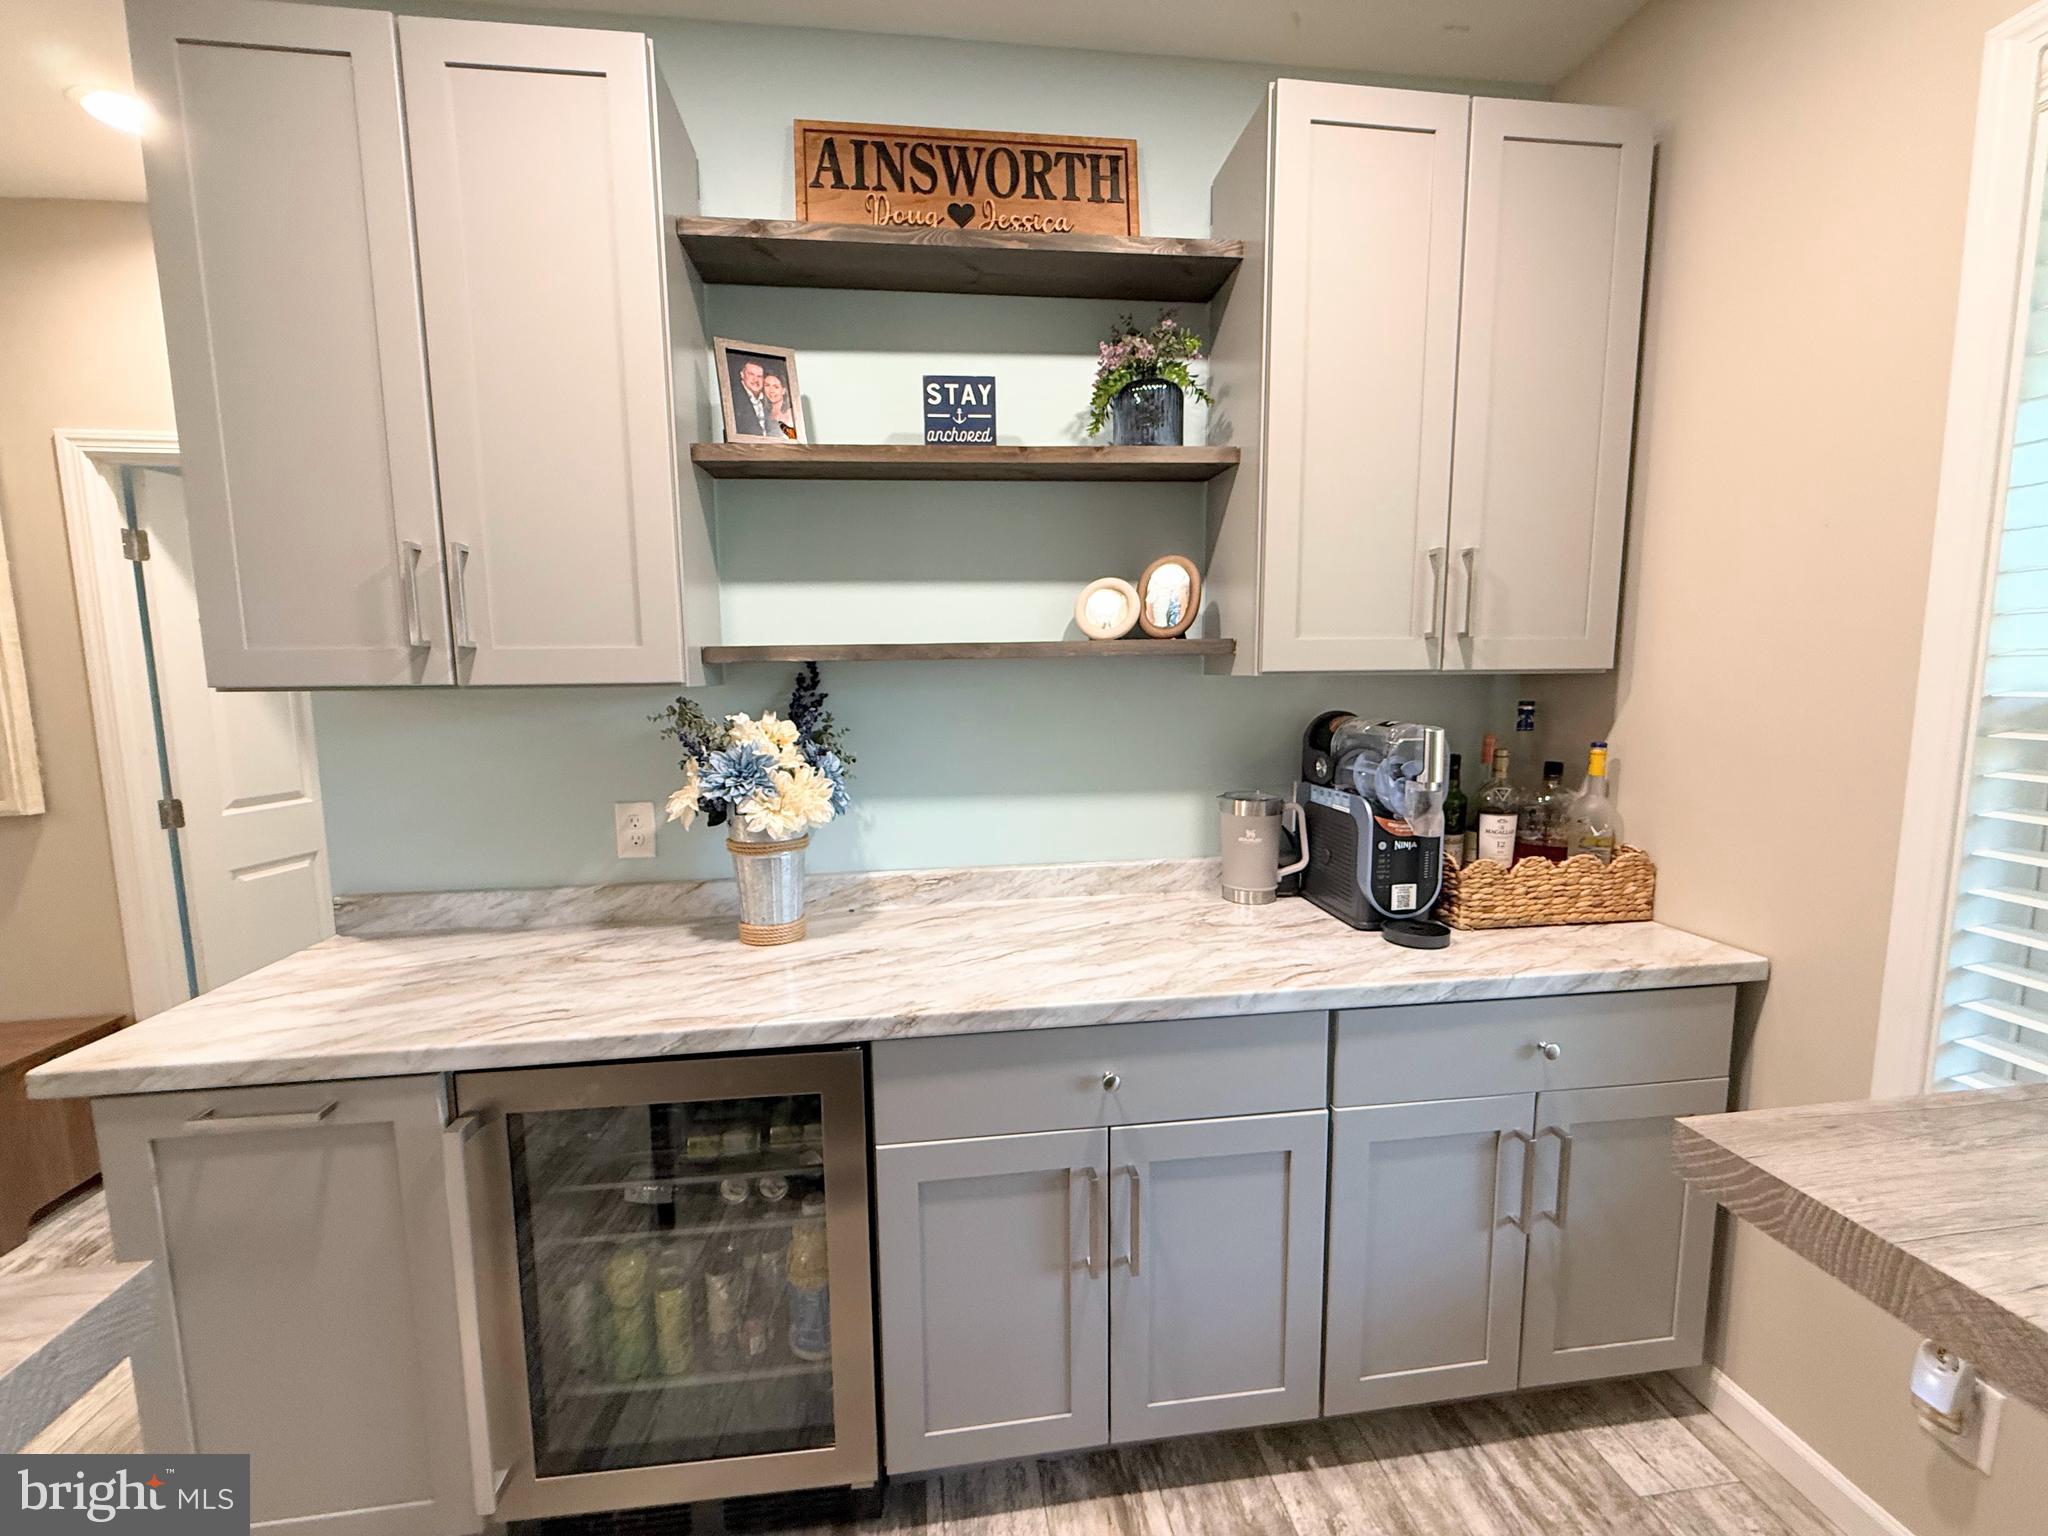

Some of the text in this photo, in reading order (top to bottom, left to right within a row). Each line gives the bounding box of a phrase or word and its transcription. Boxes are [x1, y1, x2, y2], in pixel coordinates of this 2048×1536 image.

[808, 137, 1125, 204] AINSWORTH
[865, 193, 1074, 233] Doug Jessica
[926, 382, 992, 406] STAY
[1394, 840, 1418, 851] NINJA
